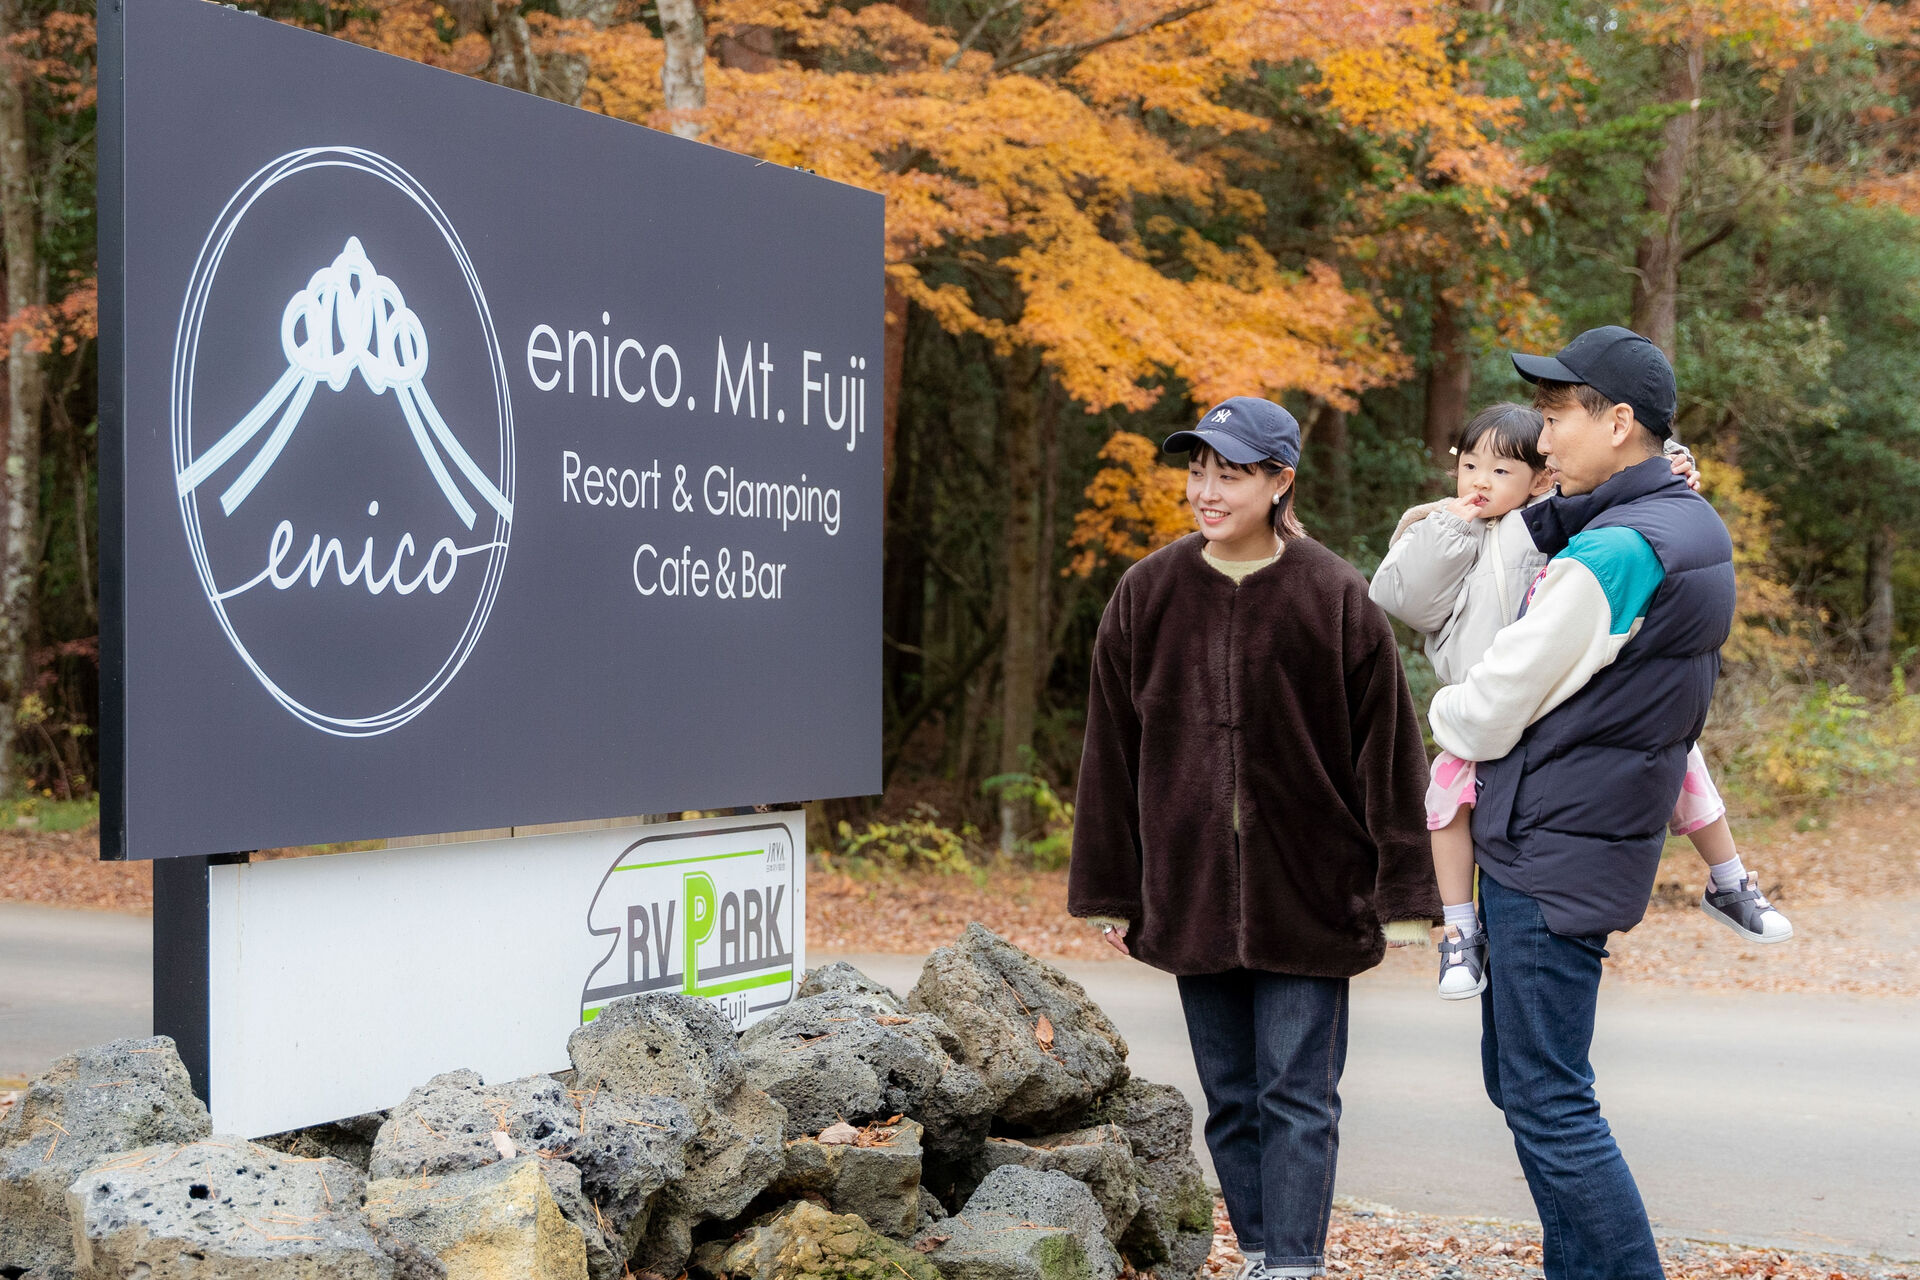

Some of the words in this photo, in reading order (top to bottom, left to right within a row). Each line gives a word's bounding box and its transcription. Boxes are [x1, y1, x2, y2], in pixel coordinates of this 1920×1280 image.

[527, 311, 696, 411] enico.
[714, 335, 785, 423] Mt.
[803, 350, 866, 452] Fuji
[563, 450, 661, 509] Resort
[672, 464, 694, 512] &
[703, 465, 840, 536] Glamping
[265, 500, 462, 597] enico
[720, 993, 746, 1026] Fuji
